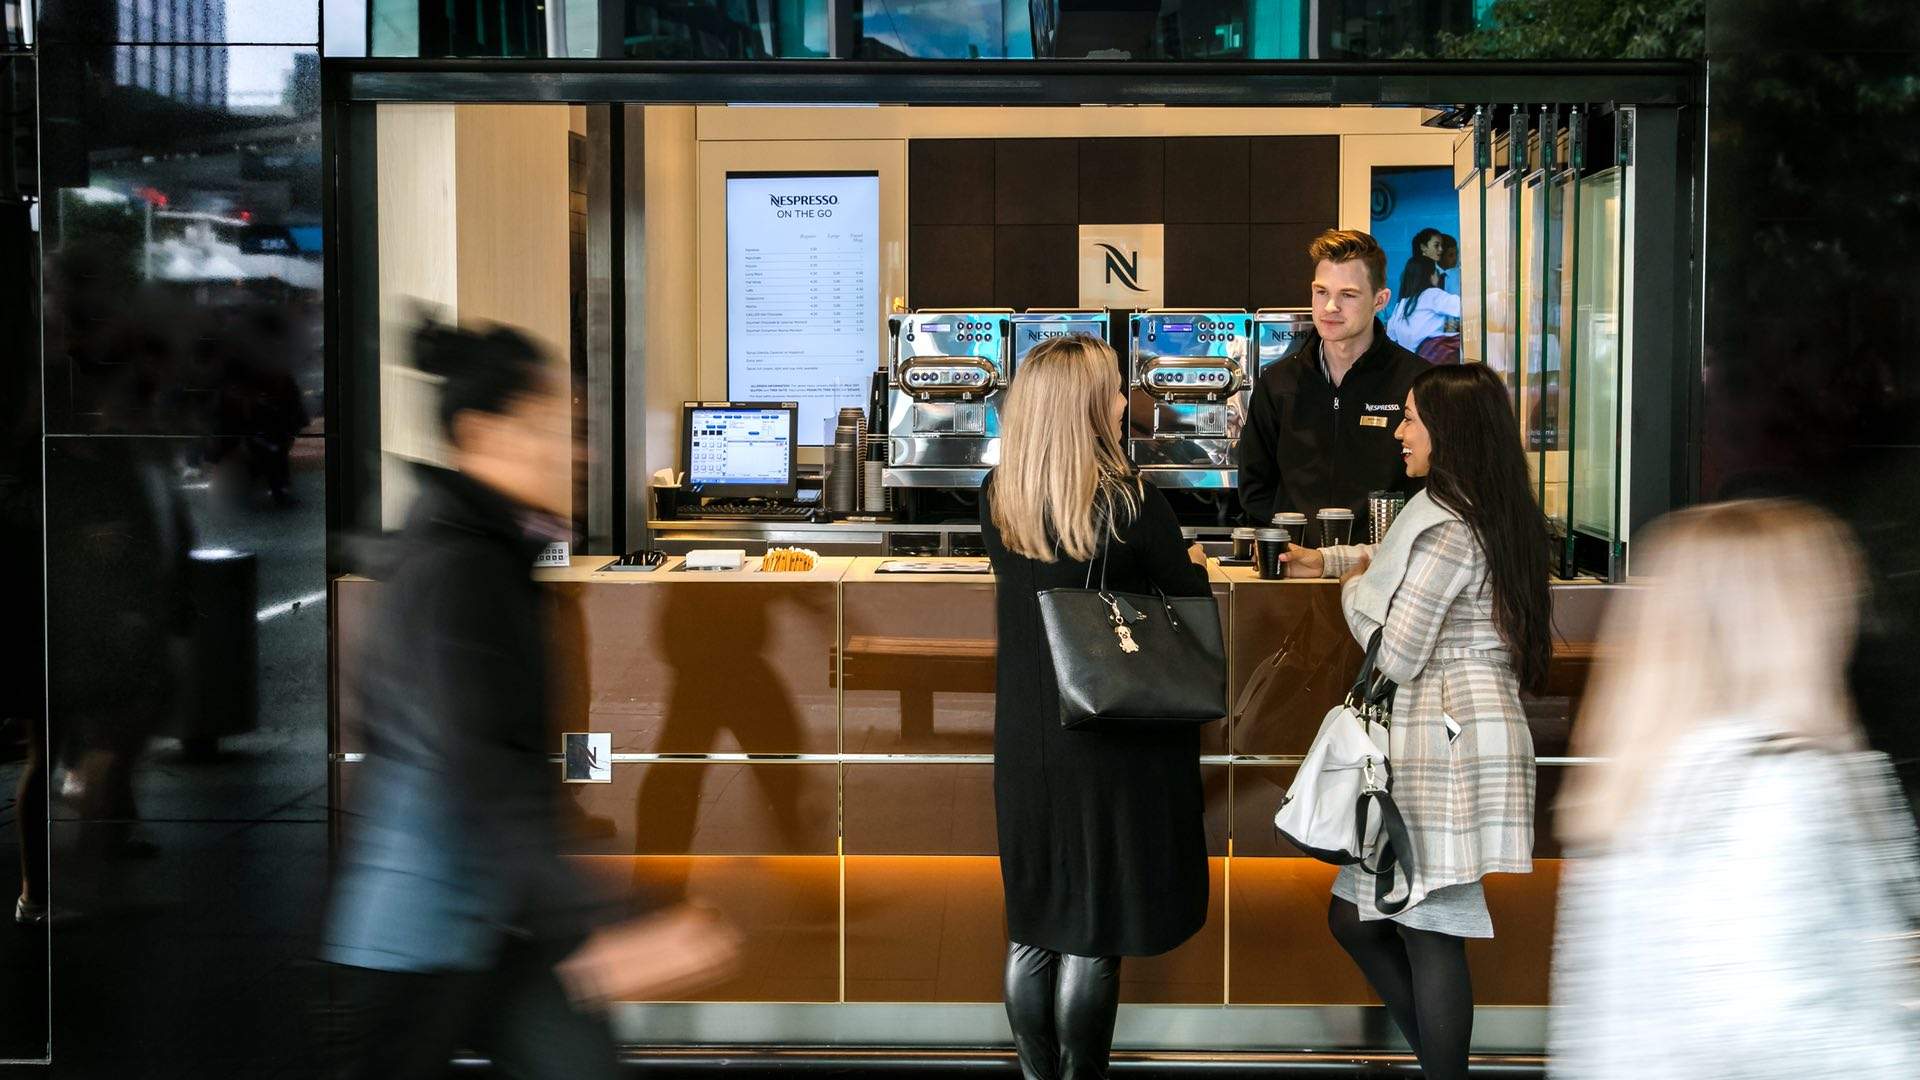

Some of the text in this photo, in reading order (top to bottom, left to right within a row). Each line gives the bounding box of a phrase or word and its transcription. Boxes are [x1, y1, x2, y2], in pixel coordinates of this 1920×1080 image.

[769, 194, 838, 207] NESPRESSO
[777, 209, 833, 218] ON THE GO
[1093, 243, 1152, 292] N
[1270, 328, 1308, 342] NESPR
